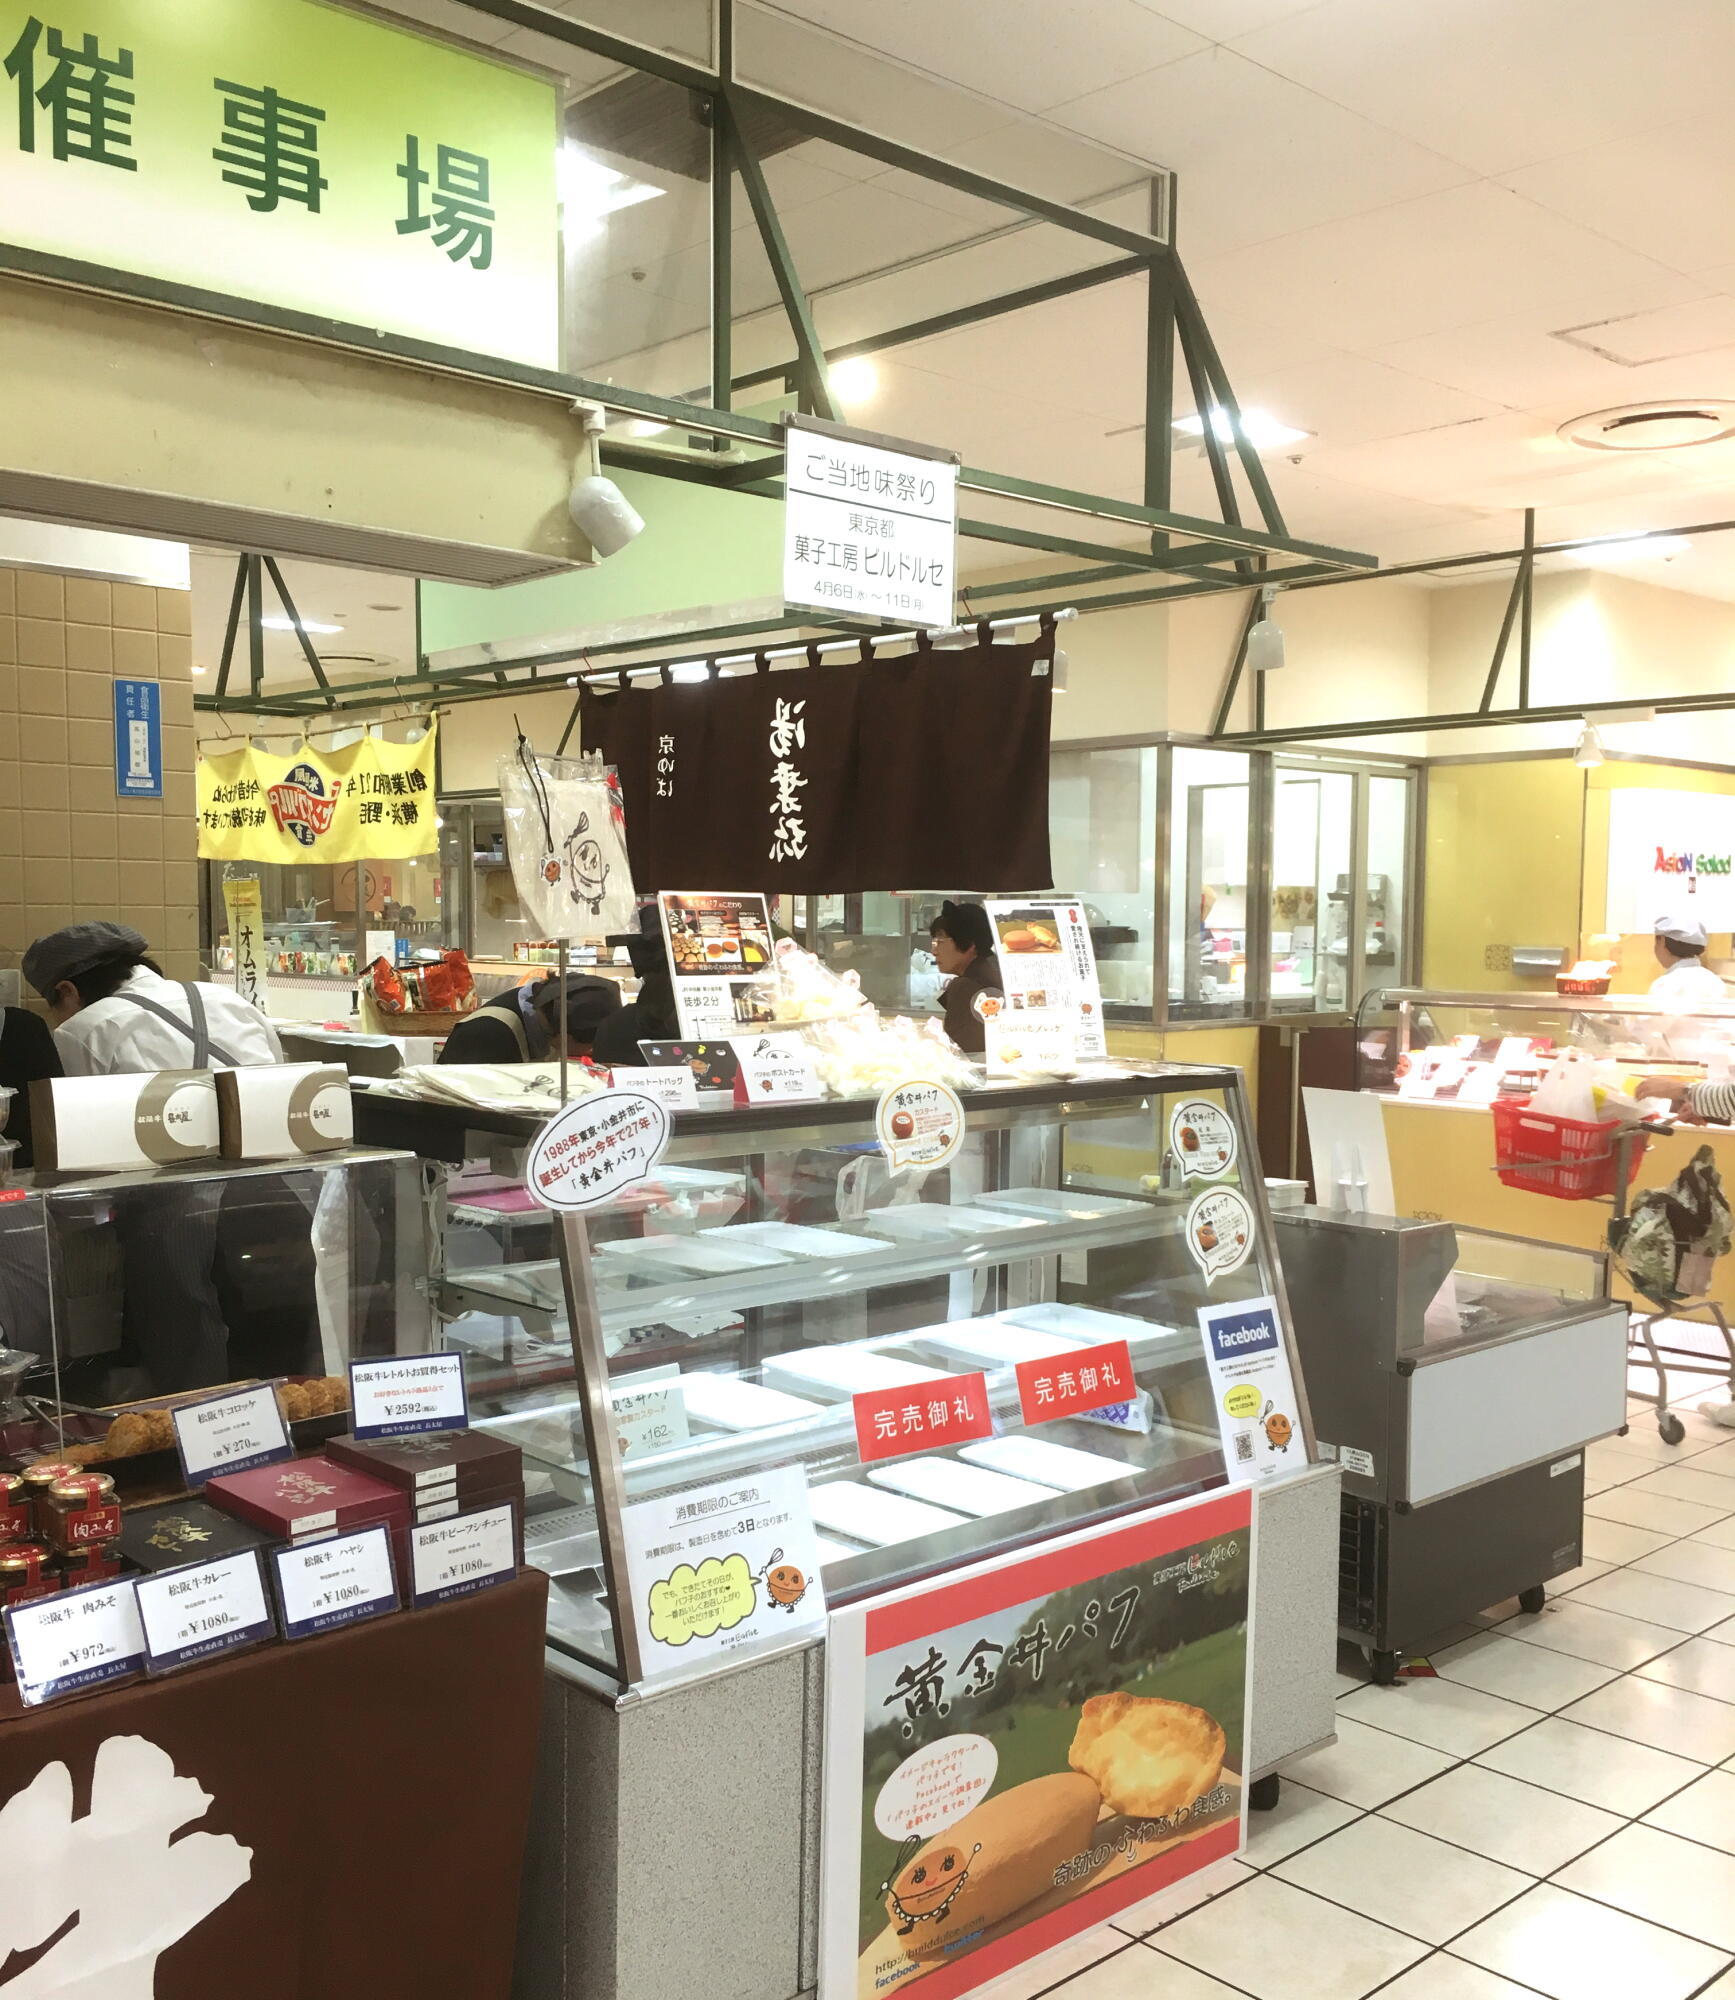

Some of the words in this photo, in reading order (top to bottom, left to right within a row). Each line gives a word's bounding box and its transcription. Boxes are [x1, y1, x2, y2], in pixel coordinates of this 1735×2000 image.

[3, 15, 496, 271] 催事場
[806, 454, 936, 506] ご当地味祭り
[848, 512, 895, 539] 東京都
[1218, 1321, 1271, 1348] facebook
[1034, 1361, 1121, 1405] 完売御礼
[197, 1399, 256, 1424] 松阪牛コロッケ
[873, 1395, 975, 1440] 完売御礼
[675, 1487, 760, 1520] 消費期限のご案内
[419, 1517, 507, 1547] 松阪牛ビーフシチュー
[304, 1551, 333, 1568] 松阪牛
[339, 1543, 365, 1557] ハヤシ
[168, 1571, 232, 1597] 松阪牛カレー
[82, 1595, 117, 1615] 肉みそ
[884, 1585, 1141, 1739] 黄金井パフ
[1053, 1785, 1233, 1888] 奇跡のふわふわ食感。
[875, 1960, 921, 1989] facebook
